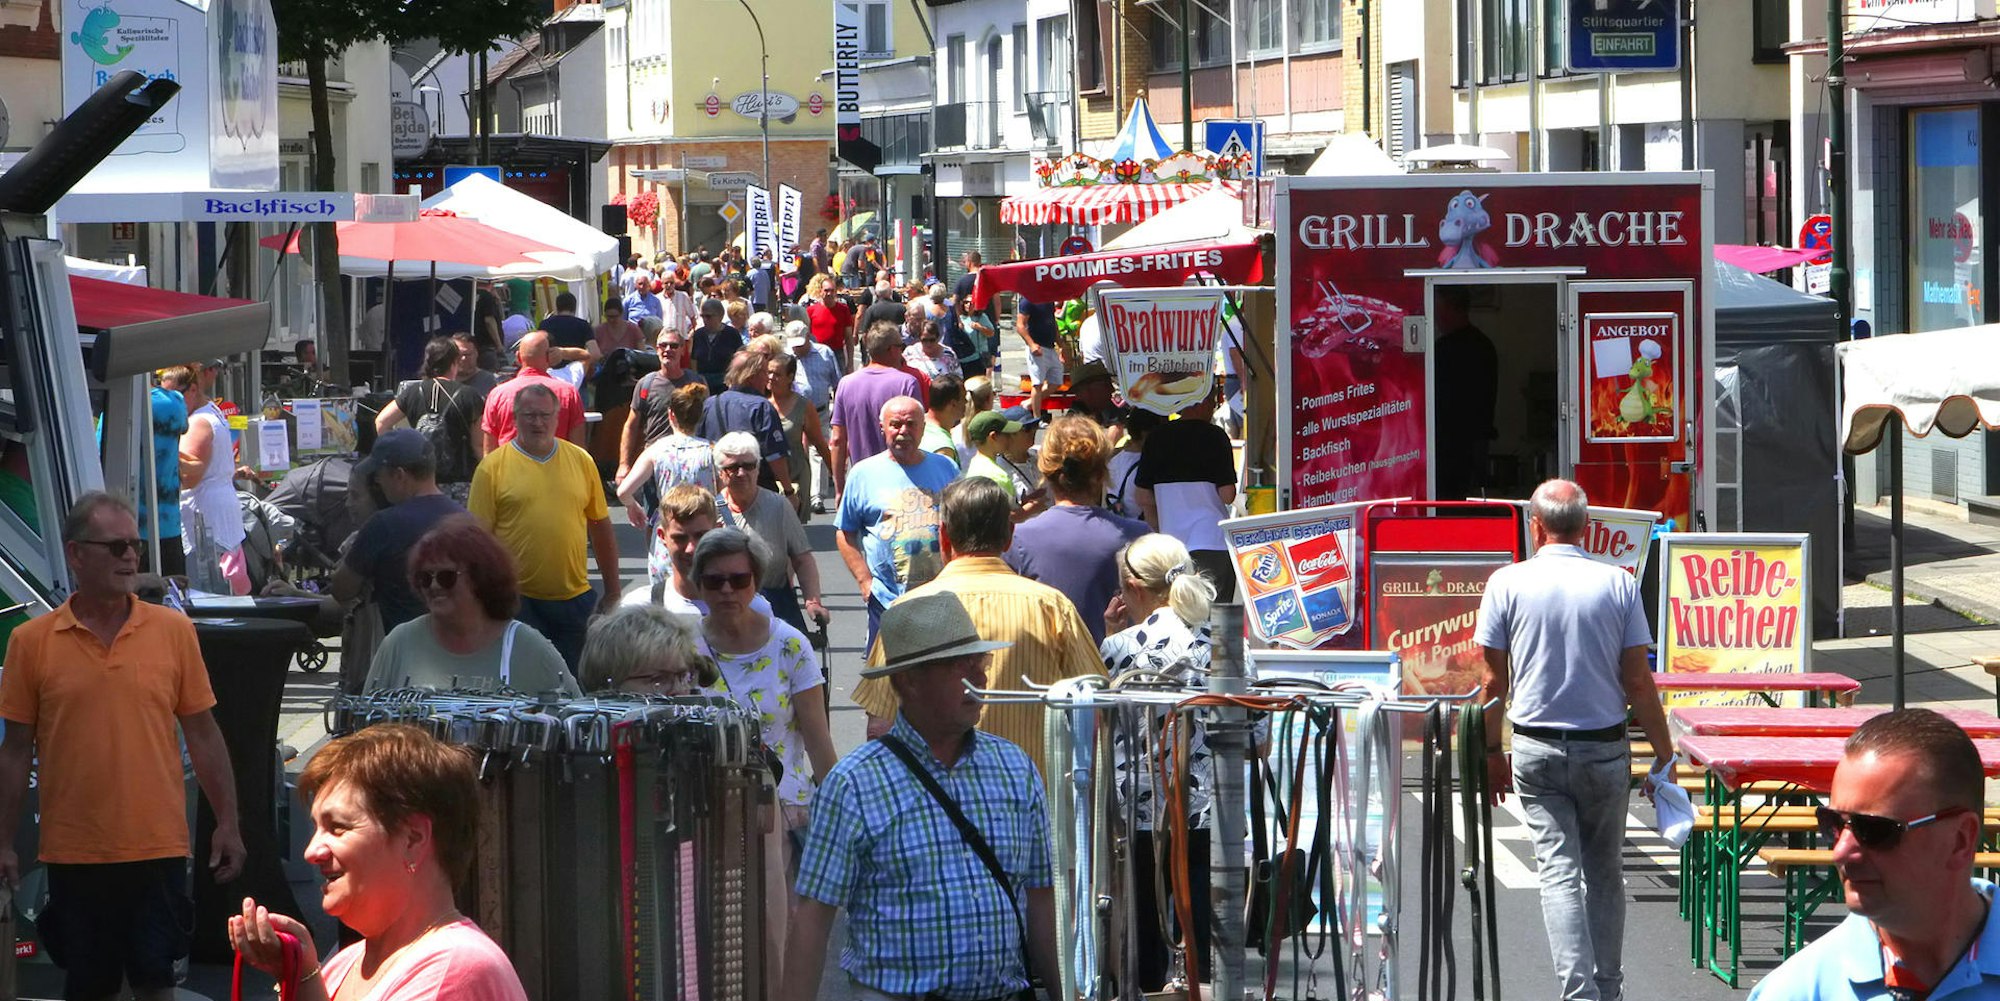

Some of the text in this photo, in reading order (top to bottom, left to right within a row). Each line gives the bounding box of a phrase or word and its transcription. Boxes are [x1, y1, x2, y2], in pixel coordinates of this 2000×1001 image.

[1582, 16, 1665, 29] Stiftsquartier
[1595, 37, 1651, 51] EINFAHRT
[837, 23, 859, 112] BUTTERFLY
[205, 199, 335, 216] Backfisch
[1299, 211, 1687, 252] GRILL DRACHE
[1035, 250, 1223, 282] POMMES-FRITES
[1111, 302, 1217, 353] Bratwurst
[1596, 325, 1668, 337] ANGEBOT
[1129, 357, 1205, 373] im Brötchen
[1302, 382, 1375, 411] Pommes Frites
[1302, 399, 1412, 437] alle Wurstspezialitäten
[1302, 437, 1351, 461] Backfisch
[1303, 461, 1366, 487] Reibekuchen
[1303, 486, 1358, 508] Hamburger
[1233, 517, 1350, 547] GEKÜHLTE GETRÄNKE
[1581, 521, 1636, 557] ibe-
[1382, 582, 1488, 593] GRILL DRAC
[1680, 550, 1797, 600] Reibe-
[1264, 597, 1294, 628] Sprite
[1669, 597, 1798, 650] kuchen
[1431, 637, 1480, 664] Pomm
